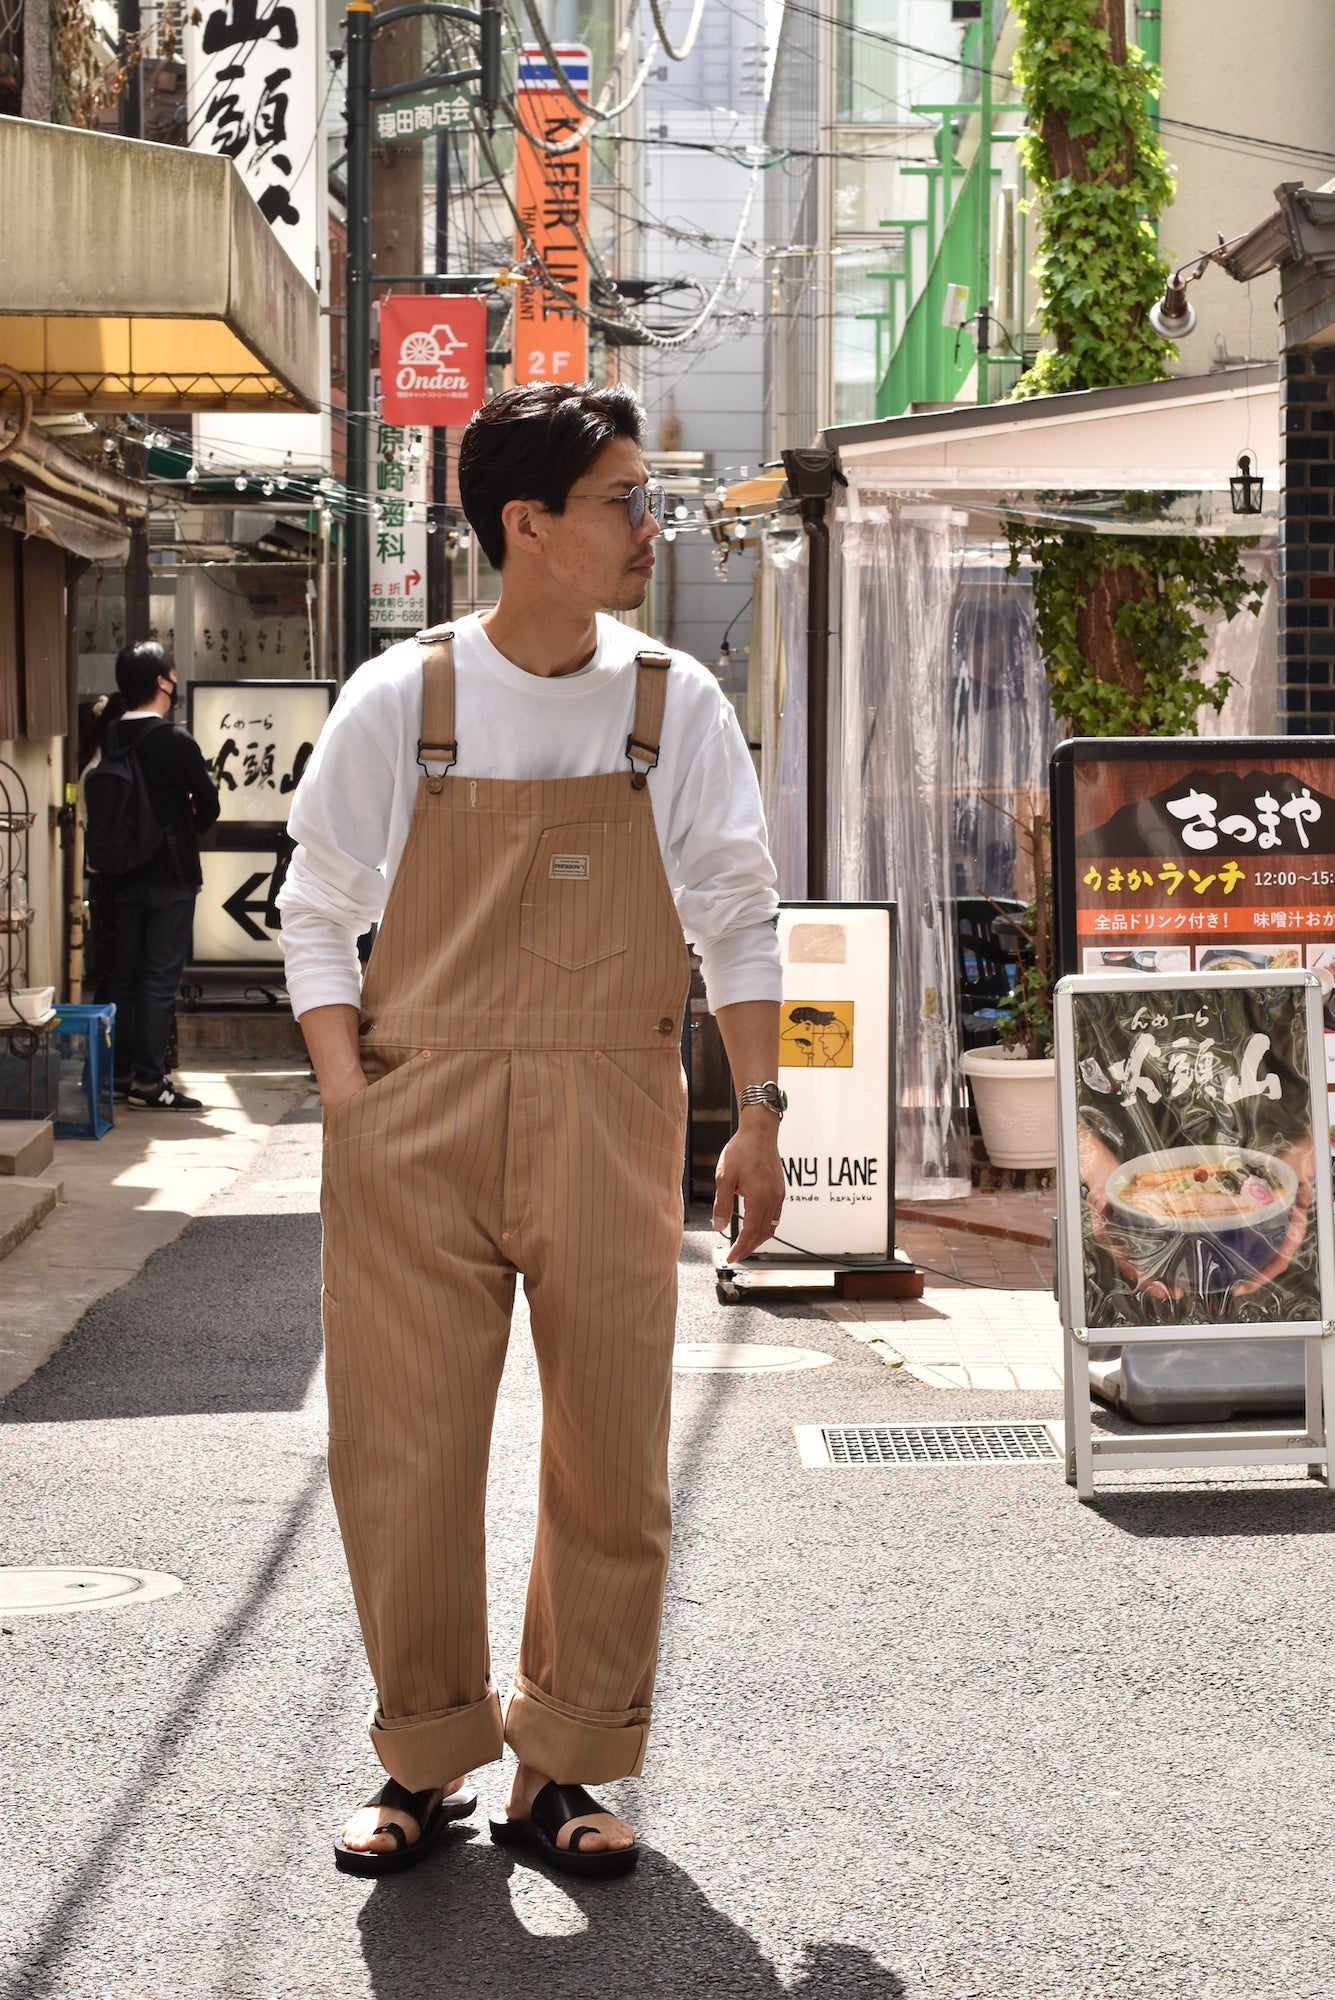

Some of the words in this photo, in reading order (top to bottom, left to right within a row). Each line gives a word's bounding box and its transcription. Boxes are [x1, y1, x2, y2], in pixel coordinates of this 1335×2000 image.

[543, 117, 580, 229] KAFFIR
[542, 245, 579, 322] LIME
[528, 351, 570, 375] 2F
[395, 366, 469, 391] Onden
[371, 583, 401, 596] 右折
[1165, 787, 1323, 851] さつまや
[1093, 910, 1229, 932] 全品ドリンク付き！
[828, 1156, 878, 1187] LANE
[829, 1191, 873, 1206] harajuku
